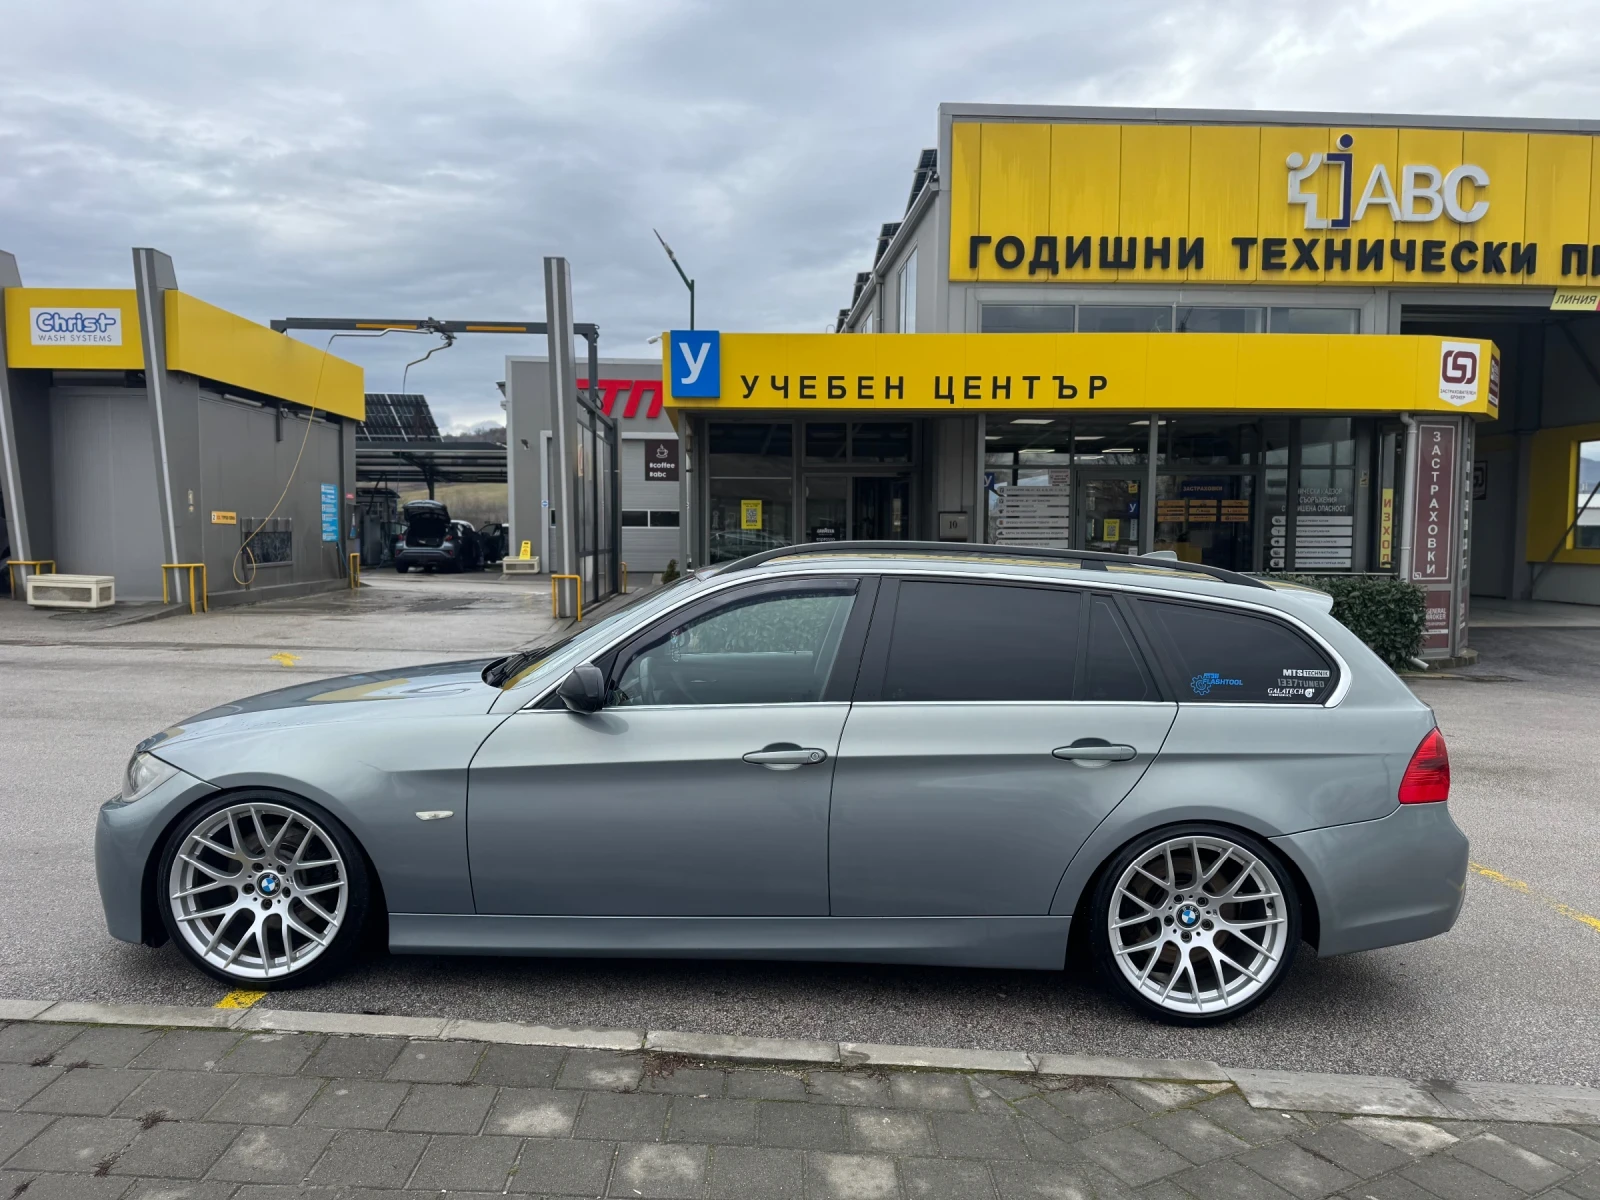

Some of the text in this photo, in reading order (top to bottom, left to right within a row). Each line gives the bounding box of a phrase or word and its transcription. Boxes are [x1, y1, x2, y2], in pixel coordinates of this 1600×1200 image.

[1352, 163, 1490, 223] ABC
[969, 235, 1204, 275] ГОДИШНИ
[1231, 237, 1537, 275] ТЕХНИЧЕСКИ
[1555, 294, 1598, 305] ЛИНИЯ
[36, 312, 116, 333] Christ
[70, 334, 112, 342] SYSTEMS
[740, 374, 1108, 404] УЧЕБЕН ЦЕНТЪР
[1426, 431, 1441, 574] ЗАСТРАХОВКИ
[948, 520, 958, 529] 10
[1283, 669, 1303, 677] MTS
